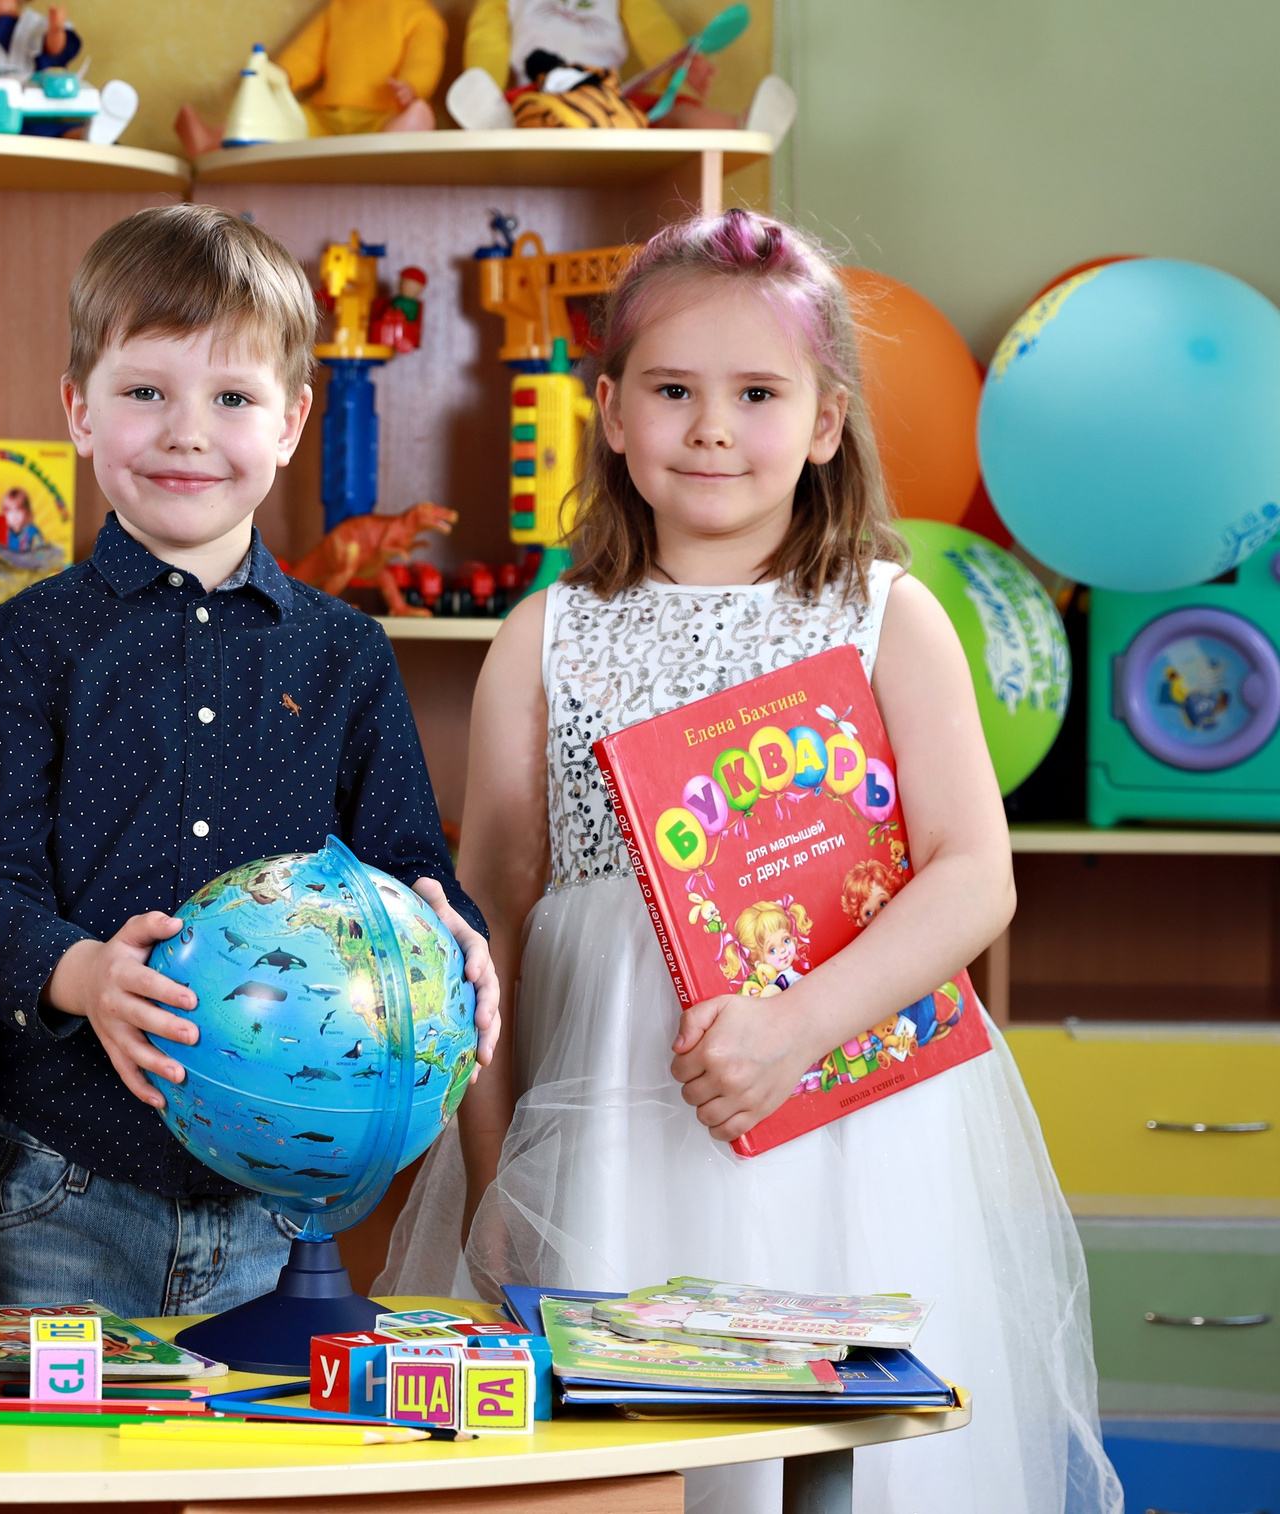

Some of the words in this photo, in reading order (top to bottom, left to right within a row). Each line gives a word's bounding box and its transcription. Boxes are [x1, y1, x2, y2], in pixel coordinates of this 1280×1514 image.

[684, 717, 736, 747] Елена
[737, 689, 808, 726] Бахтина
[665, 743, 890, 861] БУКВАРЬ
[738, 873, 753, 888] от
[756, 857, 792, 884] ДВУХ
[793, 852, 809, 868] до
[810, 832, 846, 858] ПЯТИ
[745, 846, 768, 865] для
[770, 820, 826, 854] малышей
[648, 902, 678, 972] малышей
[839, 1089, 871, 1108] школа
[872, 1073, 906, 1094] гениев
[400, 1328, 443, 1340] БА
[320, 1355, 340, 1398] У
[397, 1375, 449, 1420] ЩА
[477, 1378, 514, 1416] РА
